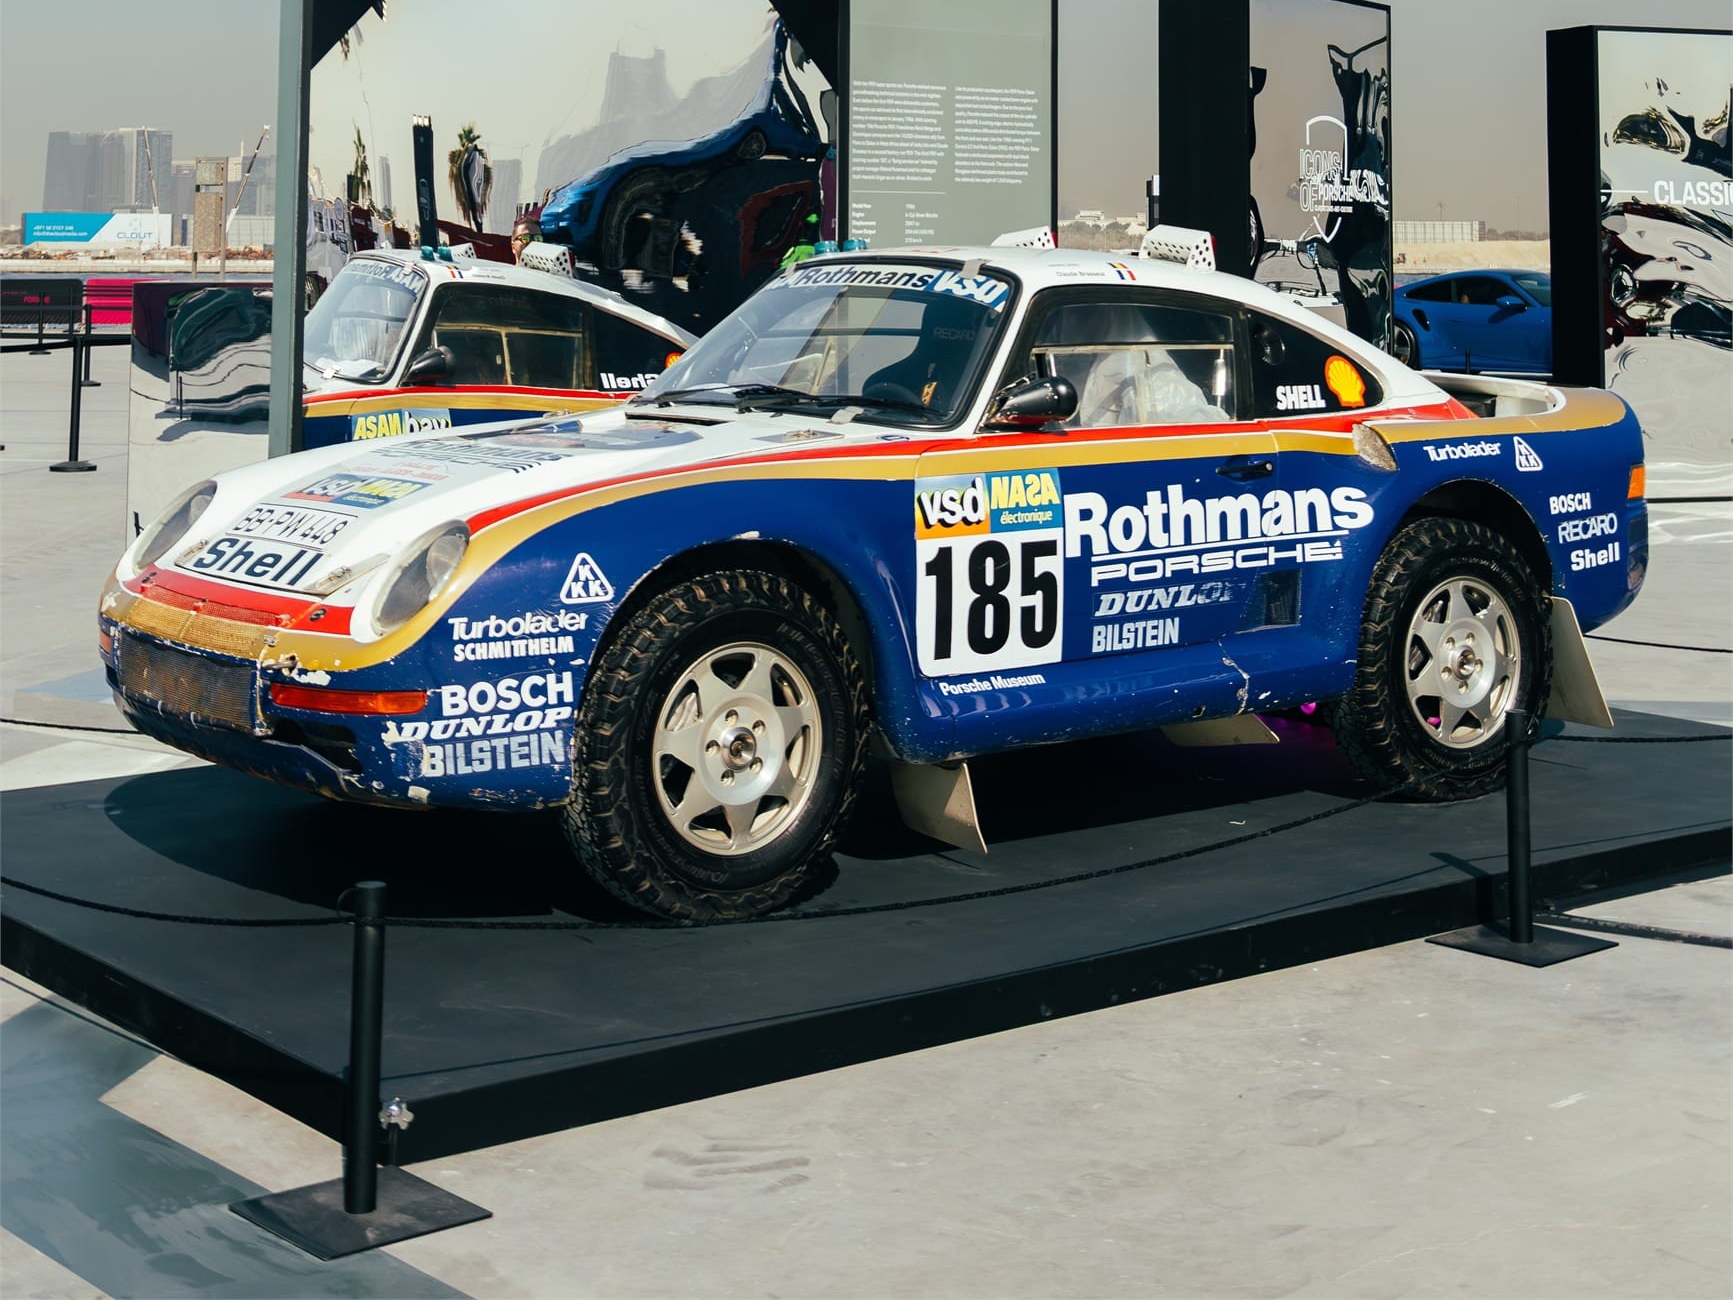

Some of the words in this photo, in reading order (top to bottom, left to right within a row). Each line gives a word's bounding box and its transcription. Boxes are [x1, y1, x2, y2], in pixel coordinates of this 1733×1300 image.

[1299, 149, 1340, 179] ICONS
[1299, 182, 1318, 212] OF
[1318, 184, 1353, 202] PORSCHE
[117, 231, 153, 239] CLOUT
[795, 266, 935, 288] Rothmans
[1276, 384, 1326, 410] SHELL
[1423, 441, 1502, 462] Turbolader
[918, 476, 986, 529] vsd
[991, 473, 1061, 509] NASA
[1549, 492, 1591, 515] BOSCH
[1000, 508, 1053, 525] électronique
[1063, 484, 1375, 558] Rothmans
[1558, 513, 1618, 544] RECARO
[193, 536, 322, 588] Shell
[1090, 539, 1344, 588] PORSCHE
[1570, 542, 1621, 572] Shell
[924, 538, 1058, 661] 185
[449, 609, 588, 641] Turbolader
[1092, 617, 1180, 653] BILSTEIN
[453, 636, 575, 662] SCHMITTHELM
[441, 671, 574, 717] BOSCH
[939, 677, 991, 697] Porsche
[993, 672, 1045, 691] Museum
[406, 706, 574, 742] DUNLOP
[423, 730, 566, 778] BILSTEIN
